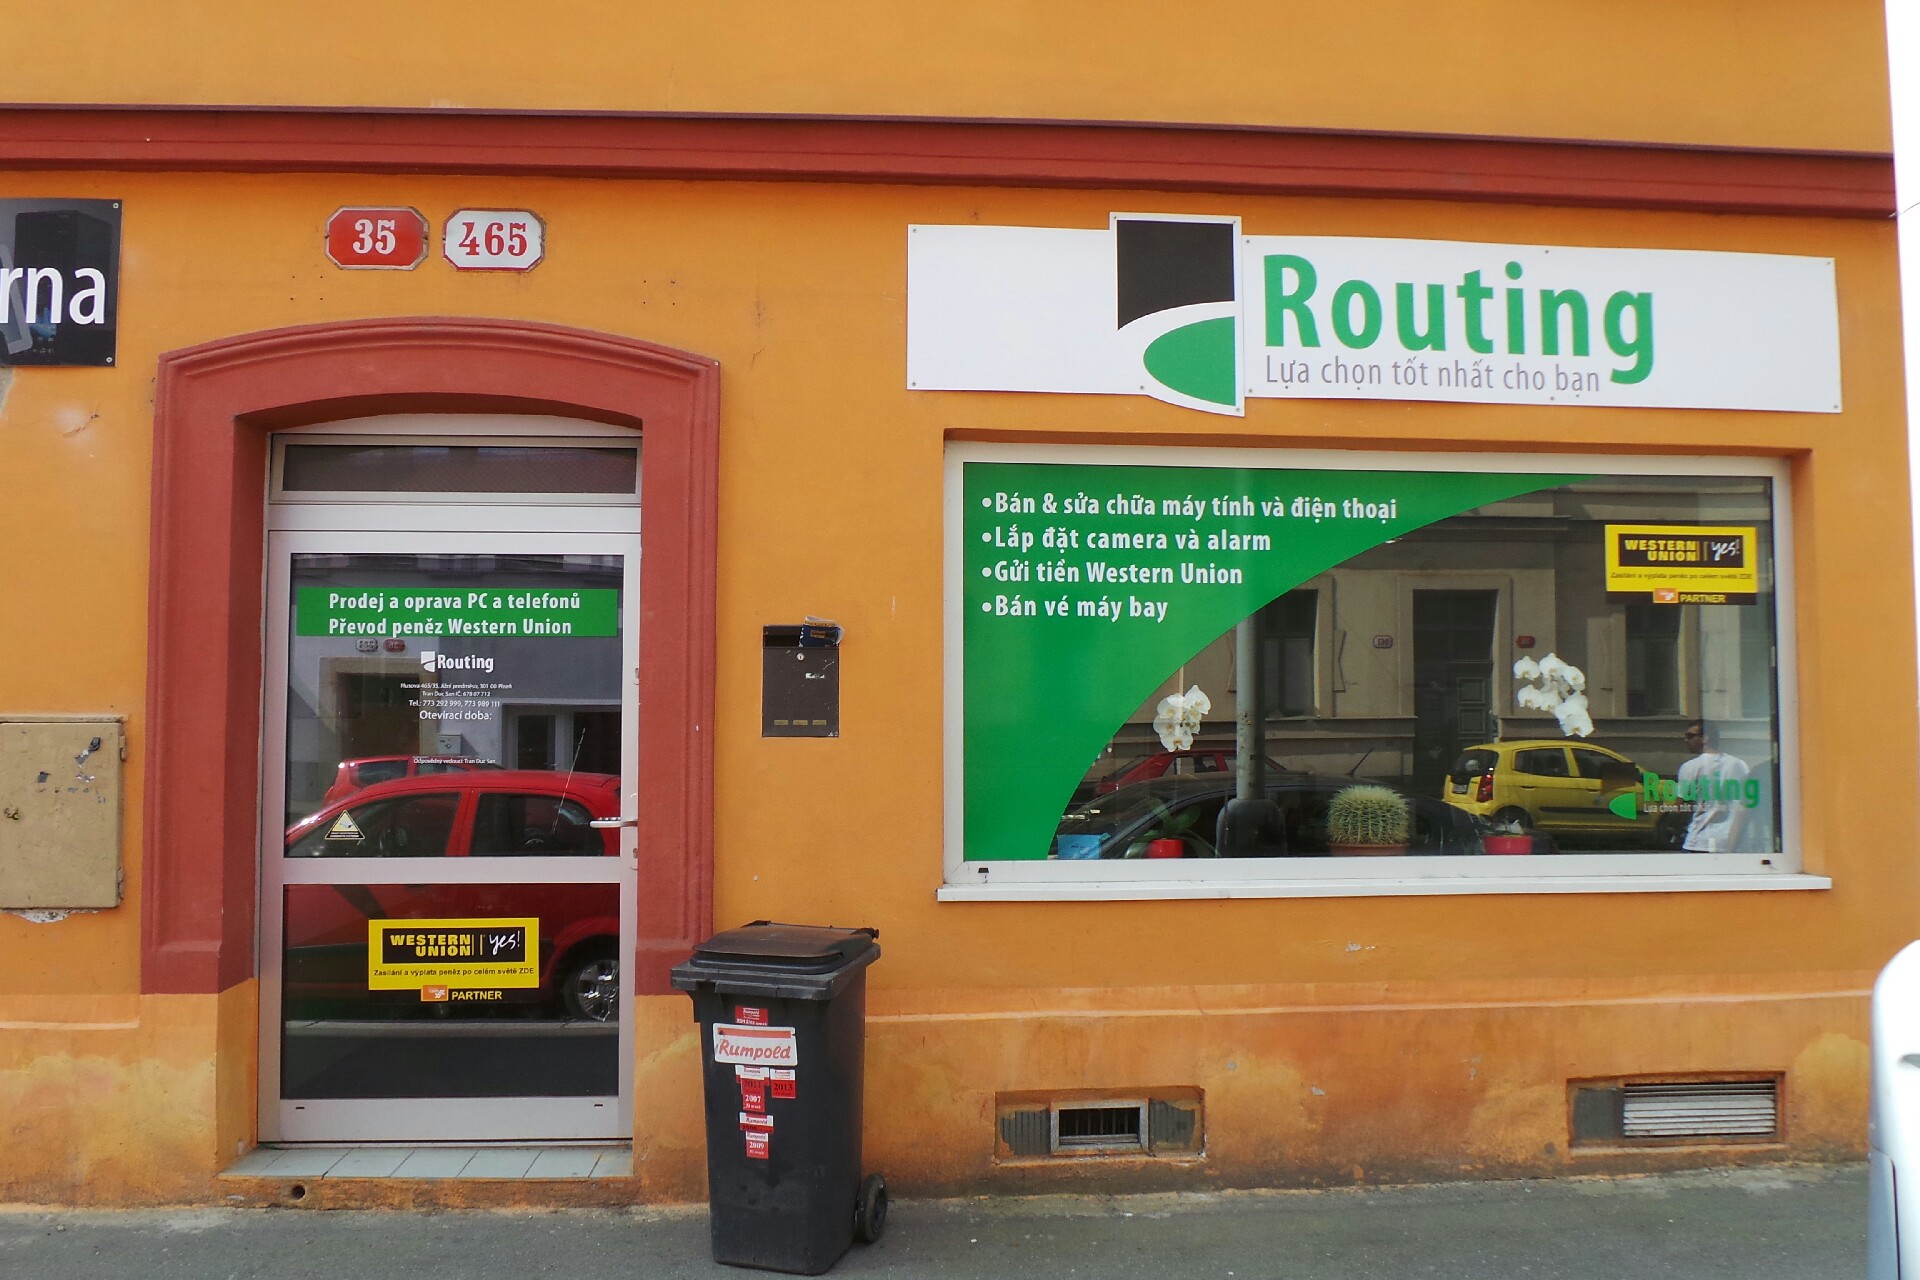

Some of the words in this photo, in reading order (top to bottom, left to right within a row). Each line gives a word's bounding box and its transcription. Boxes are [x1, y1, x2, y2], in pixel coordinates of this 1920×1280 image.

[352, 218, 397, 255] 35
[458, 221, 528, 257] 465
[1261, 253, 1655, 385] Routing
[1265, 354, 1310, 390] Lựa
[1320, 355, 1382, 391] chọn
[1391, 355, 1430, 387] tốt
[1437, 358, 1494, 389] nhất
[1502, 361, 1545, 392] cho
[1555, 363, 1600, 395] bạn
[995, 491, 1036, 515] Bán
[1042, 493, 1058, 515] &
[1063, 490, 1100, 517] sửa
[1106, 491, 1158, 517] chữa
[1162, 493, 1206, 522] máy
[1211, 494, 1255, 518] tính
[1260, 496, 1285, 518] và
[1290, 495, 1337, 525] điện
[1342, 497, 1398, 525] thoại
[995, 523, 1035, 554] Lắp
[1042, 526, 1079, 555] đặt
[1086, 533, 1168, 551] camera
[1174, 529, 1200, 551] và
[1207, 529, 1271, 552] alarm
[1624, 538, 1698, 551] WESTERN
[1646, 550, 1698, 562] UNION
[995, 558, 1030, 584] Gửi
[1036, 558, 1080, 584] tiền
[1085, 561, 1174, 585] Western
[1180, 562, 1243, 586] Union
[329, 592, 384, 613] Prodej
[389, 596, 399, 610] a
[404, 596, 462, 613] oprava
[467, 592, 488, 610] PC
[492, 596, 502, 610] a
[508, 592, 581, 610] telefonů
[995, 593, 1037, 618] Bán
[1044, 594, 1069, 618] vé
[1077, 596, 1122, 623] máy
[1128, 596, 1169, 624] bay
[1680, 594, 1726, 604] PARTNER
[329, 617, 387, 636] Převod
[392, 617, 443, 639] peněz
[447, 618, 517, 636] Western
[523, 618, 572, 635] Union
[437, 654, 494, 673] Routing
[422, 700, 435, 708] 773
[436, 700, 448, 708] 292
[419, 709, 463, 721] Otevírací
[1643, 771, 1759, 808] Routing
[390, 935, 471, 946] WESTERN
[488, 930, 521, 956] yes!
[415, 945, 471, 957] UNION
[462, 969, 472, 978] po
[519, 967, 534, 975] ZDE
[451, 990, 503, 1001] PARTNER
[718, 1038, 792, 1061] Rumpold
[774, 1082, 793, 1091] 2013
[745, 1094, 761, 1104] 2007
[749, 1141, 765, 1150] 2009
